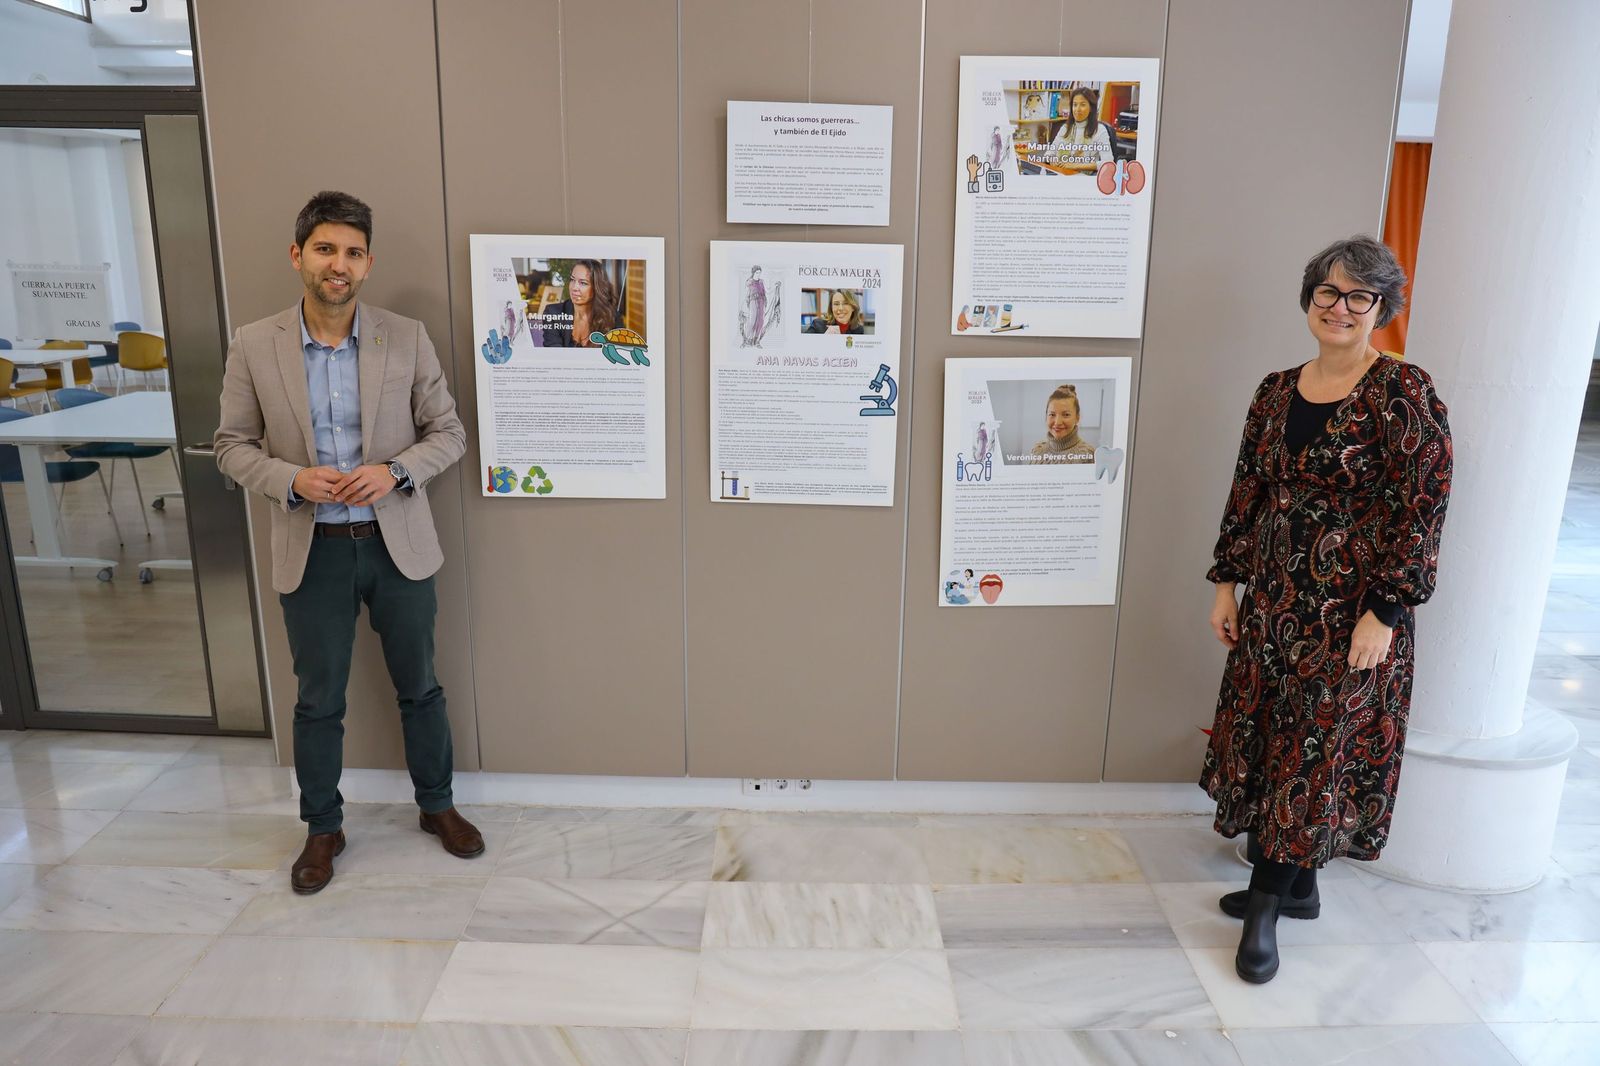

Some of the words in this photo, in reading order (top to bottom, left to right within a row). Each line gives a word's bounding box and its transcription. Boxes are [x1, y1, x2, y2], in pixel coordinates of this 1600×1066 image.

[773, 115, 795, 123] chicas
[810, 128, 820, 136] de
[829, 129, 847, 137] Ejido
[1027, 142, 1056, 151] María
[1058, 143, 1110, 152] Adoración
[1027, 154, 1060, 163] Martín
[1061, 155, 1096, 164] Gómez
[798, 266, 838, 276] PORCIA
[840, 268, 881, 278] MAURA
[21, 281, 51, 289] CIERRA
[65, 282, 96, 290] PUERTA
[862, 278, 882, 288] 2024
[528, 312, 574, 322] Margarita
[65, 320, 101, 328] GRACIAS
[529, 322, 553, 331] López
[756, 355, 780, 366] ANA
[783, 356, 819, 367] NAVAS
[1006, 453, 1042, 461] Verónica
[1043, 453, 1066, 461] Pérez
[1067, 453, 1093, 461] García
